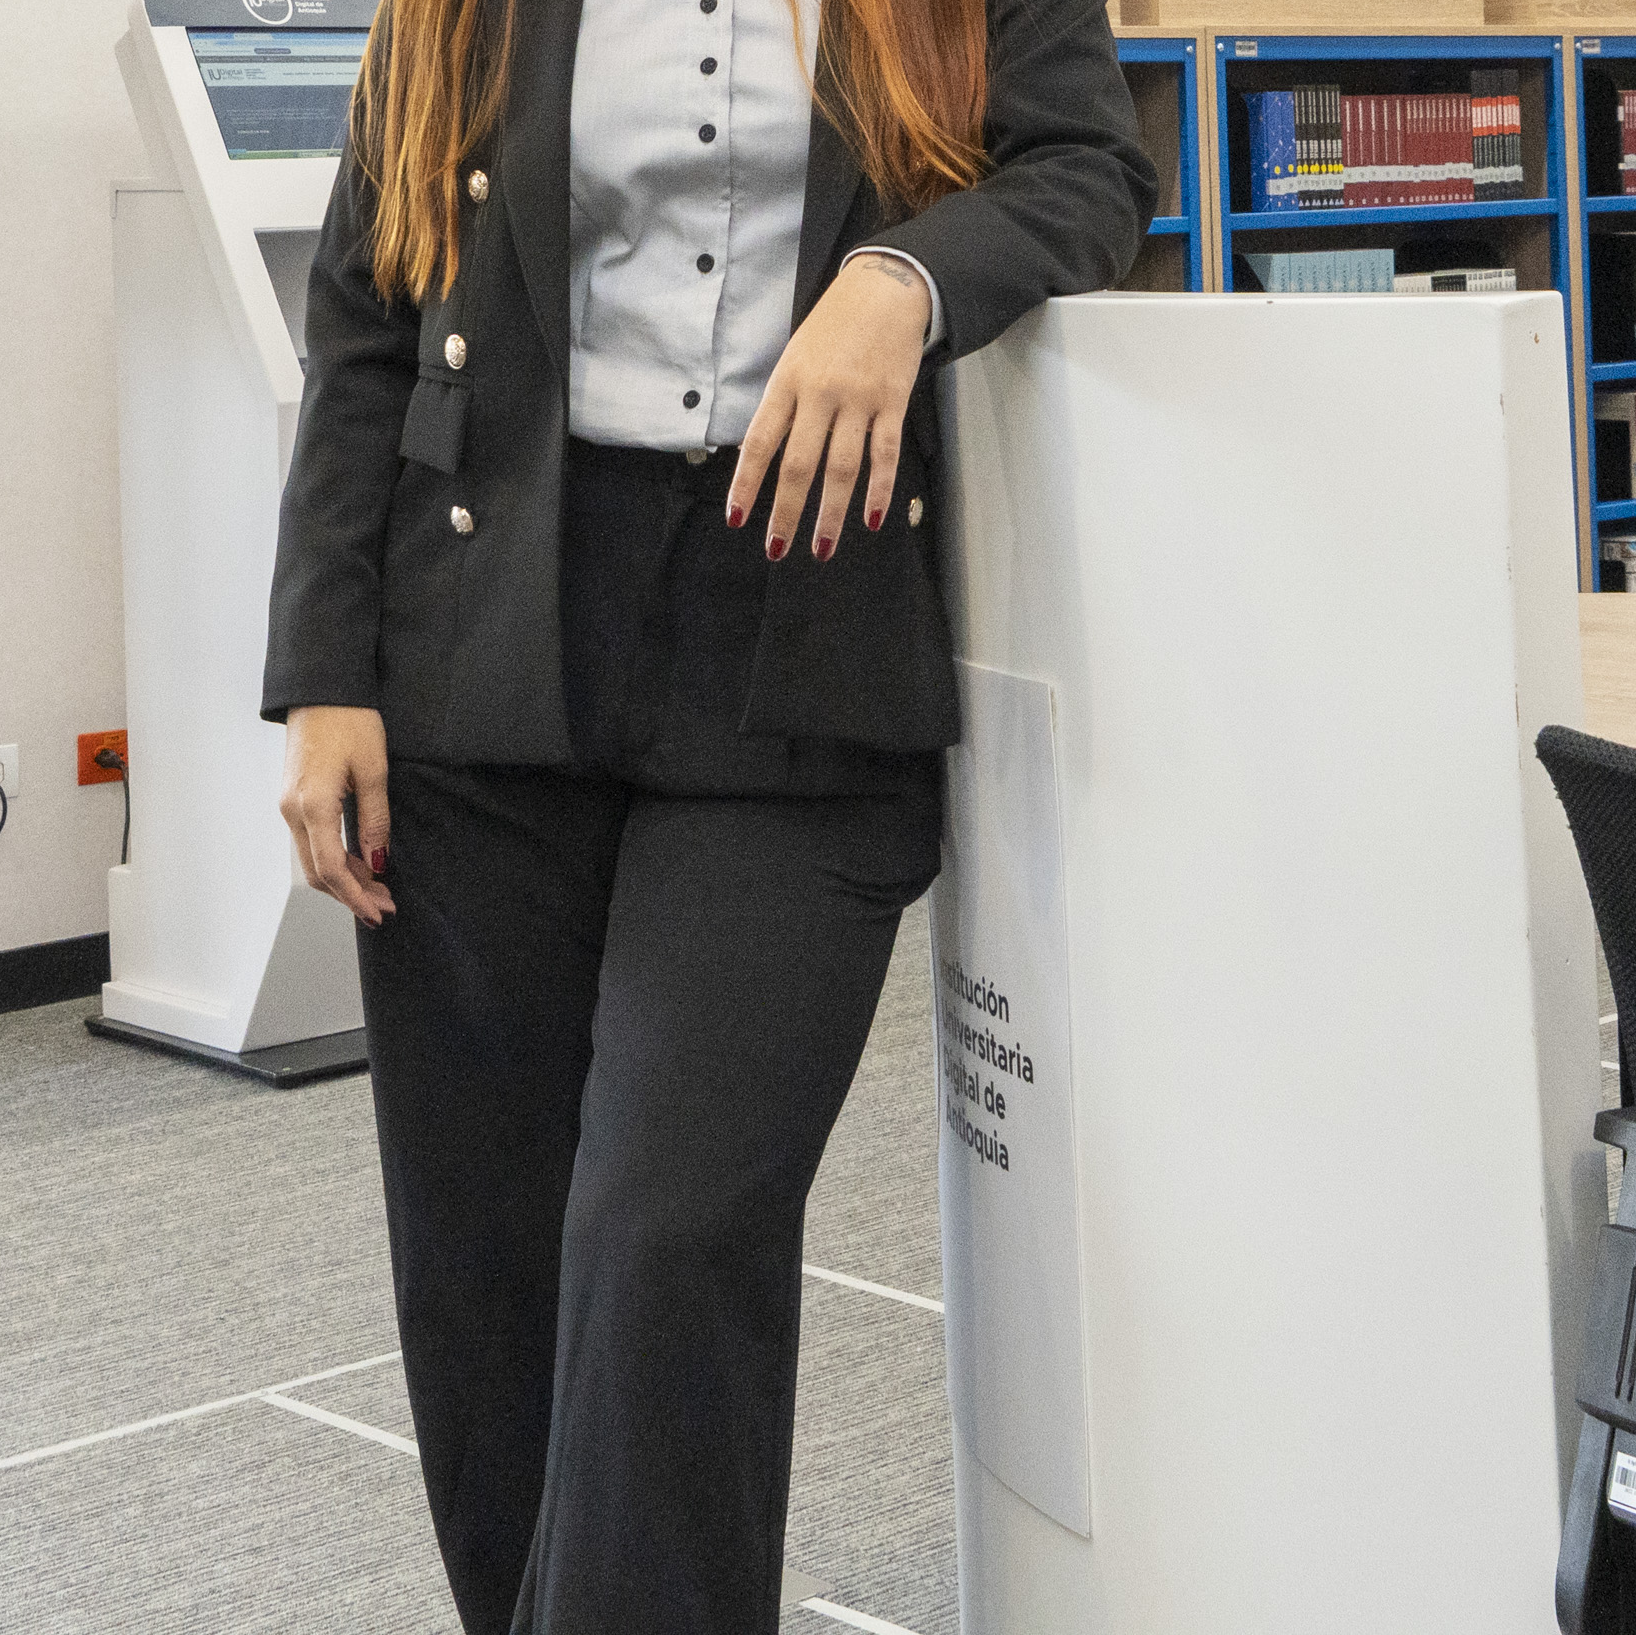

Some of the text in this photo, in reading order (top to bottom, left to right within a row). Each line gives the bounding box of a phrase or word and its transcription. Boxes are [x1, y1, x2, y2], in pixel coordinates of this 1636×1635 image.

[942, 997, 1034, 1084] Universitaria
[944, 1045, 1006, 1120] Digital de
[946, 1094, 1009, 1172] Antioquia
